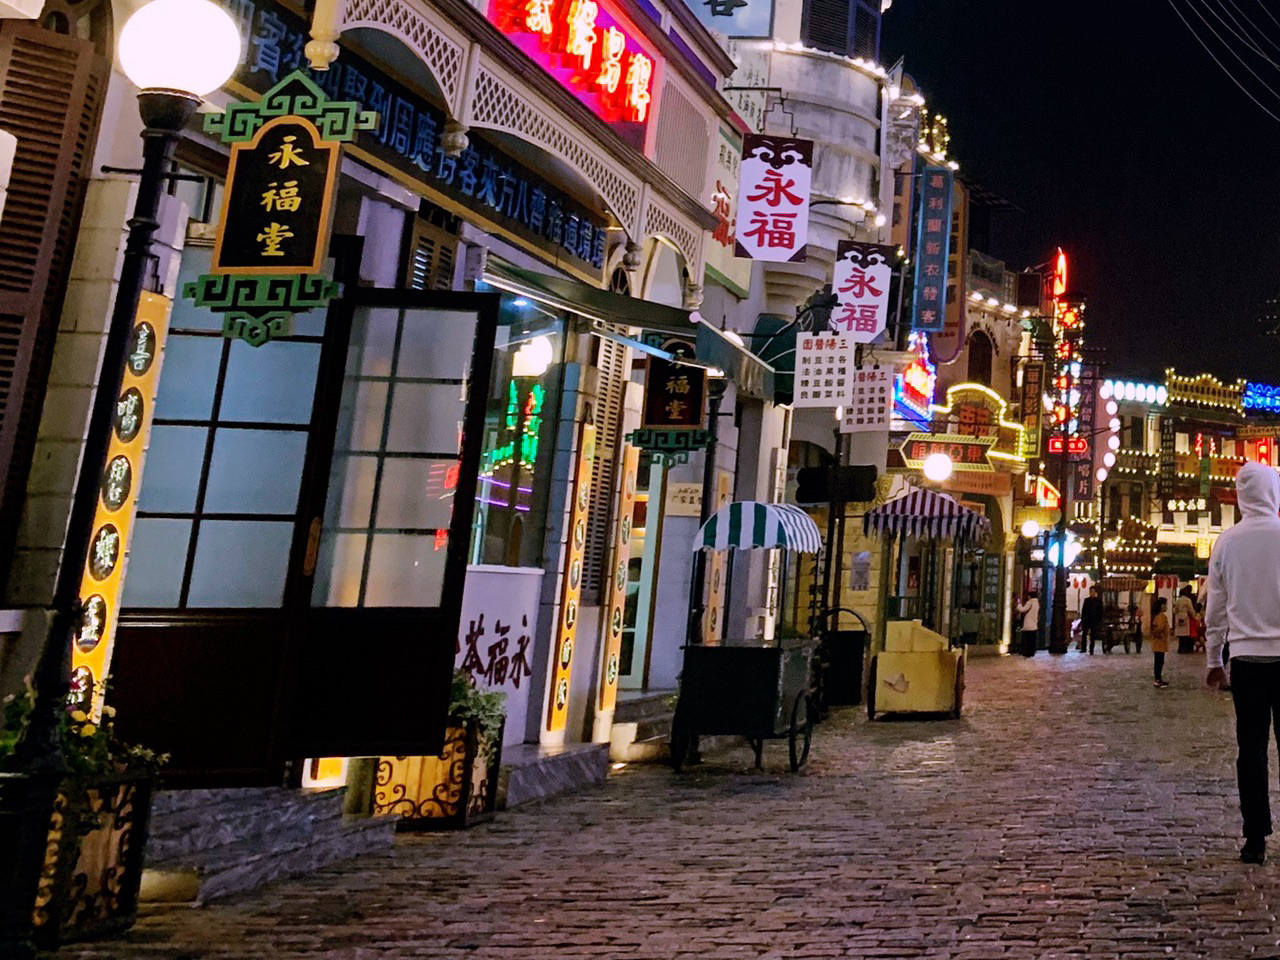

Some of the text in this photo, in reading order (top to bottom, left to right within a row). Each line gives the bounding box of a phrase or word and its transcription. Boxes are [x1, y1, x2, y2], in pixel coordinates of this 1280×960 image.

[255, 135, 310, 257] 永福堂
[743, 169, 804, 250] 永福
[836, 267, 883, 334] 永福
